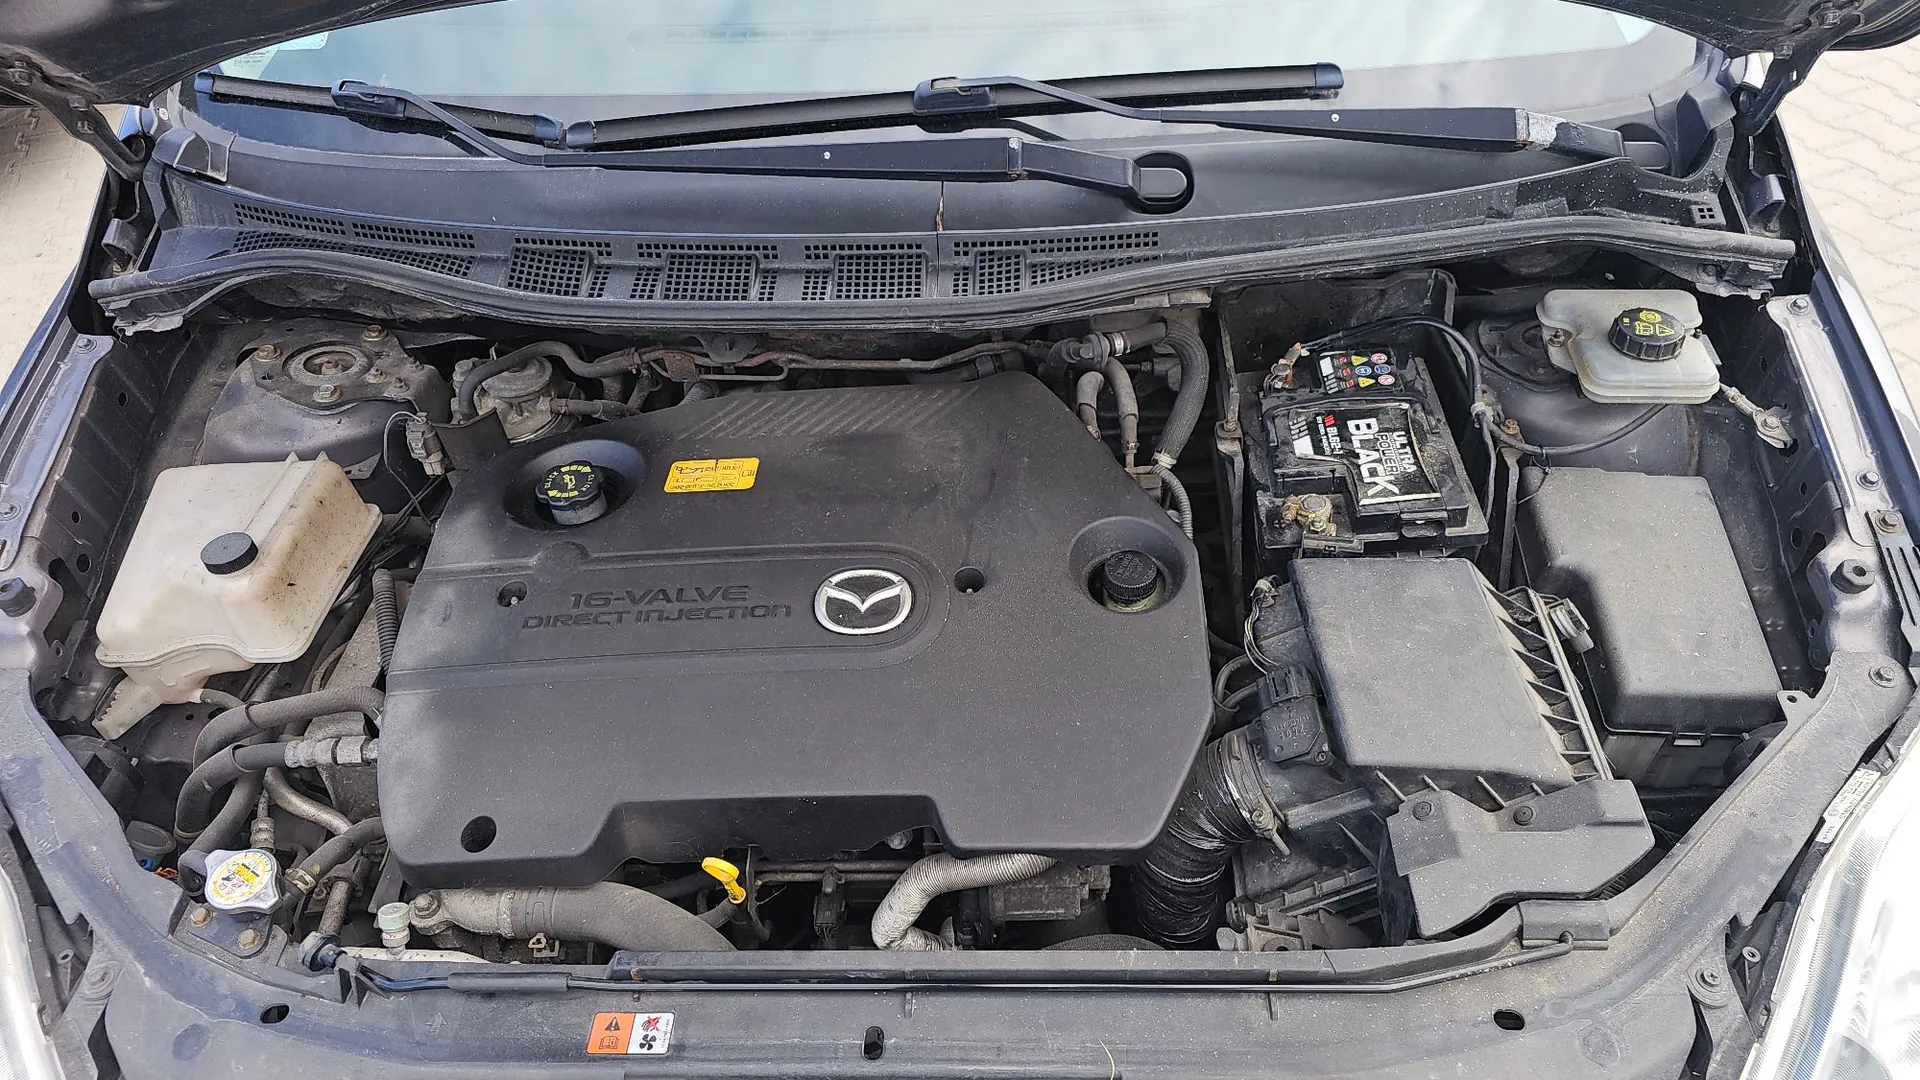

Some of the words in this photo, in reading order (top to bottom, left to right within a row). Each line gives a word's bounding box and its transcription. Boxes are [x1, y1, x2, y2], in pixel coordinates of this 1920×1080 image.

[1347, 418, 1399, 496] BLACK
[1375, 432, 1400, 474] POWER
[1392, 431, 1417, 472] ULTRA
[544, 471, 559, 489] CLICK
[580, 474, 595, 492] CLICK
[571, 585, 749, 609] 16-VALVE
[522, 611, 630, 630] DIRECT
